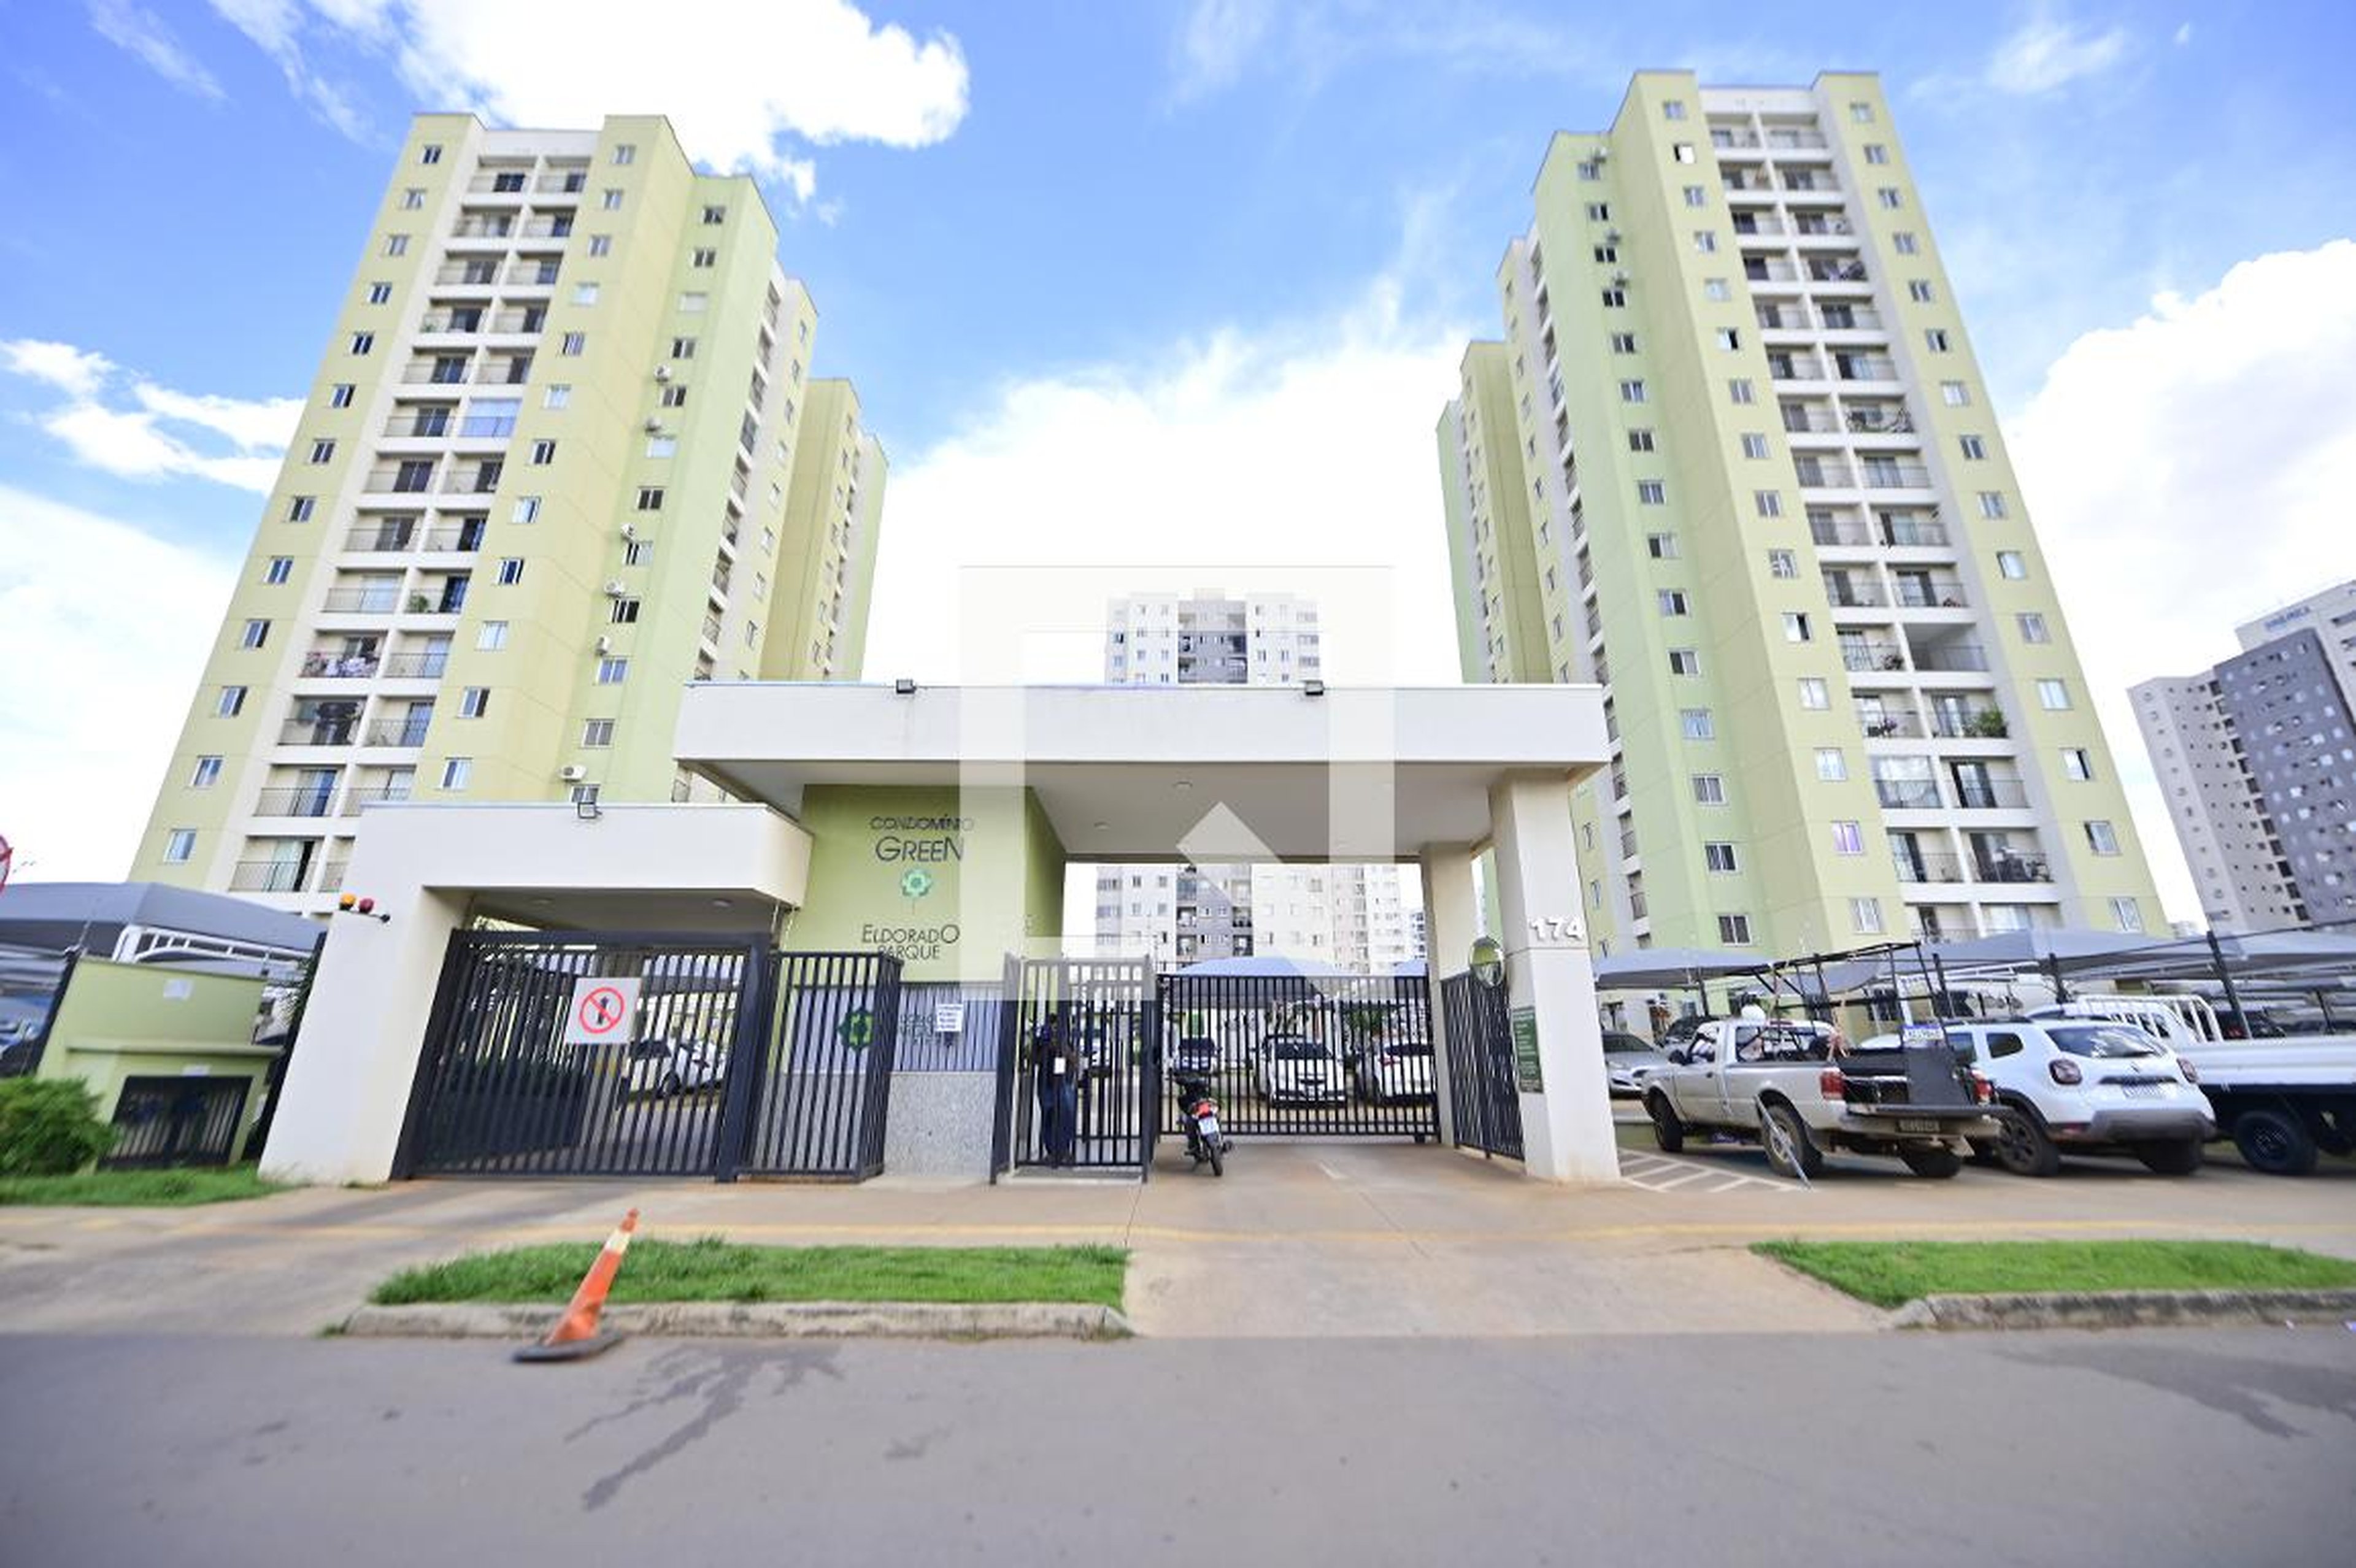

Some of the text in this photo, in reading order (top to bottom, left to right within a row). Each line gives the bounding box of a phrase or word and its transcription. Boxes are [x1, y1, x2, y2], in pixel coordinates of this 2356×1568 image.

[876, 836, 964, 861] GREEN
[861, 924, 960, 943] ELDORADO
[1529, 917, 1584, 941] 174
